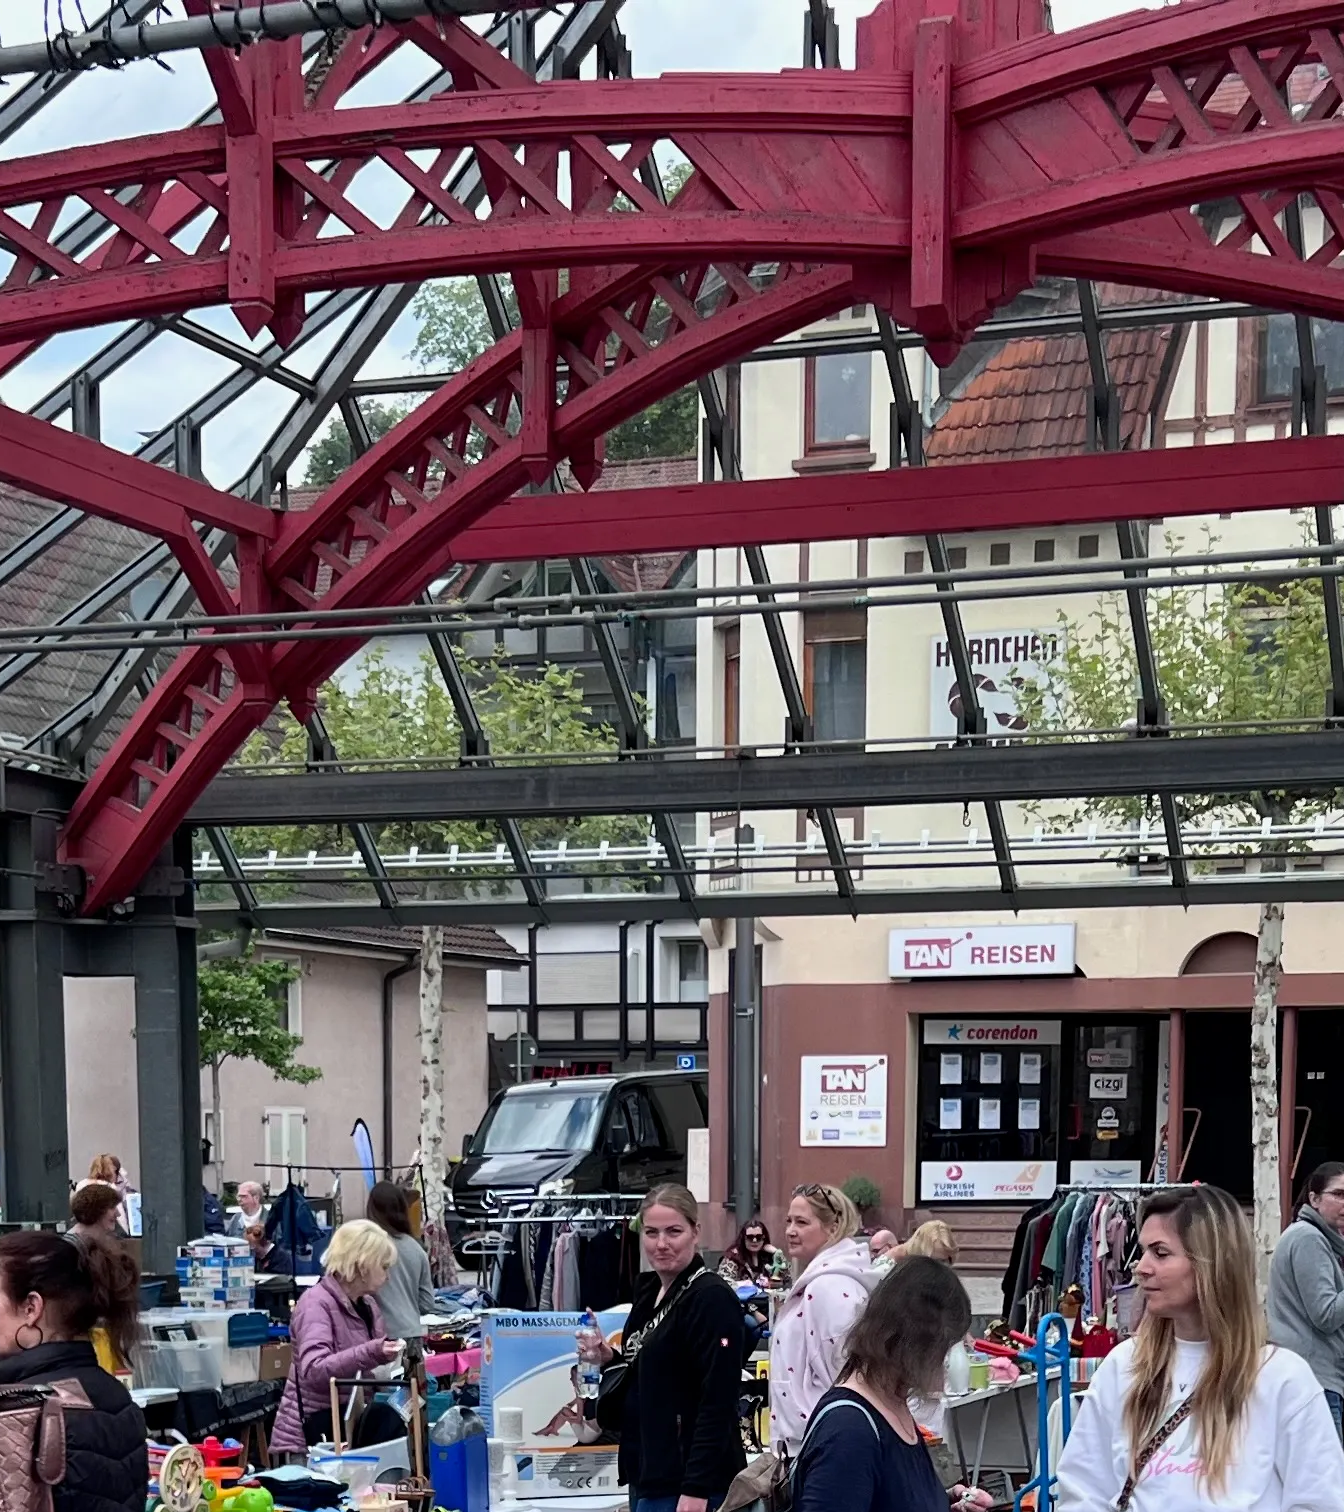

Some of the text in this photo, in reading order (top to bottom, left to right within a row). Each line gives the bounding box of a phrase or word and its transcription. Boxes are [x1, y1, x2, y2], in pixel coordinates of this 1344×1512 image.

[936, 634, 1057, 667] HRNCHEN
[905, 945, 1056, 967] TAN REISEN
[967, 1025, 1038, 1040] corendon
[822, 1069, 865, 1090] TAN
[820, 1095, 867, 1106] REISEN
[495, 1317, 582, 1327] MBO MASSAGEMA
